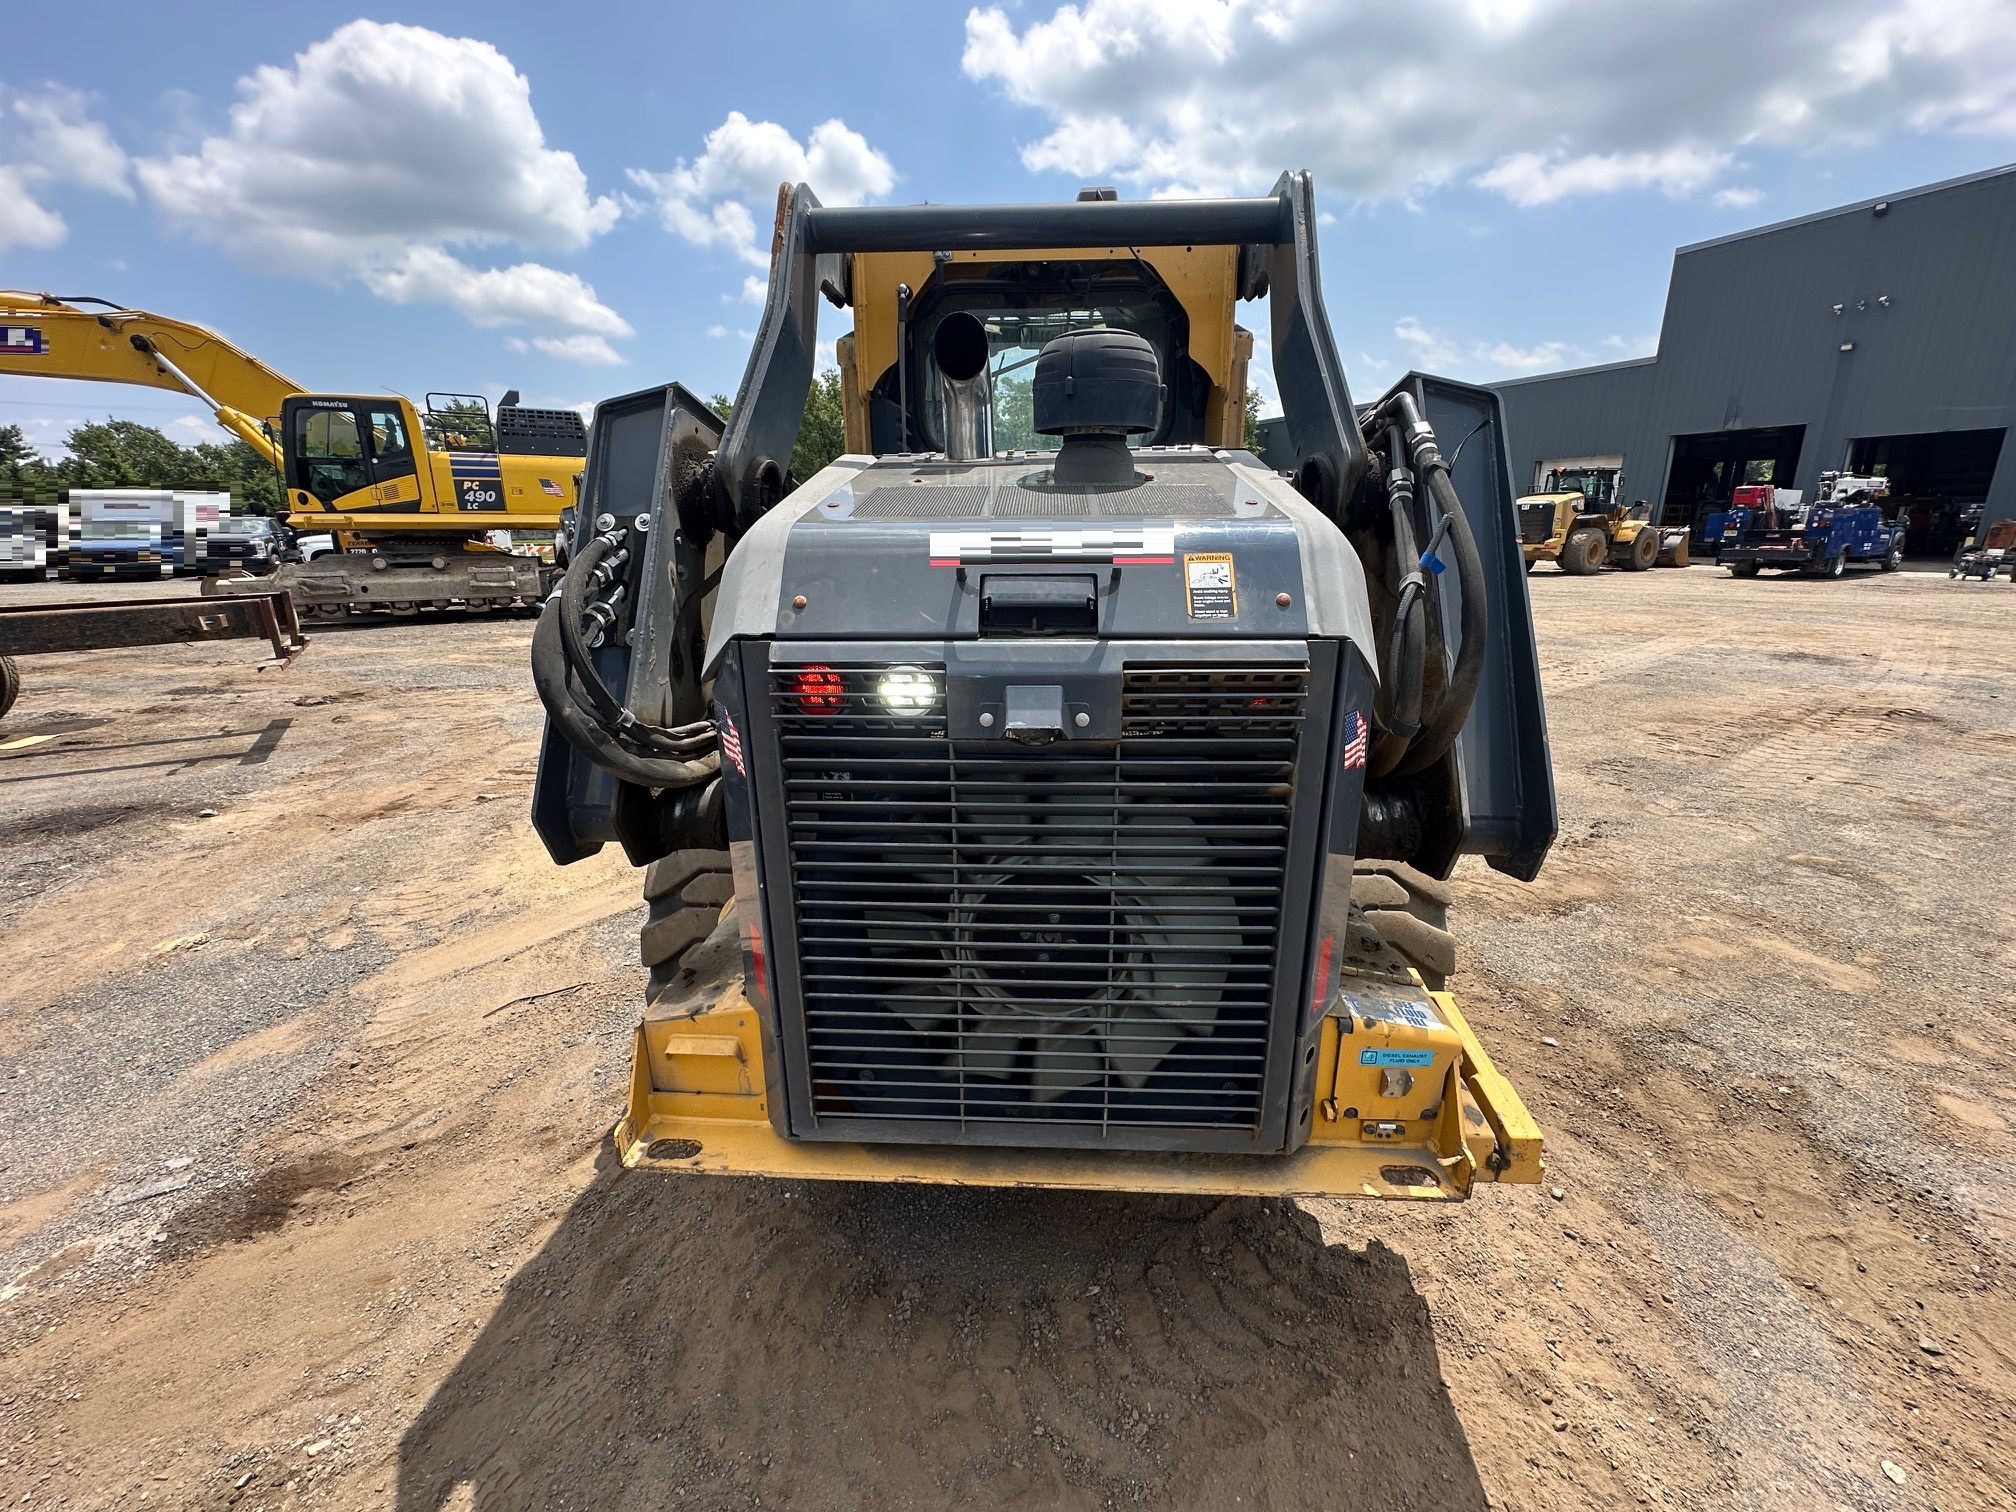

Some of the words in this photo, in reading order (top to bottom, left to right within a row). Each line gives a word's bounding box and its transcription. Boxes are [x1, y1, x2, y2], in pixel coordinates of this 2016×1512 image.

[463, 481, 480, 490] PC
[464, 490, 496, 502] 490
[1394, 1006, 1427, 1018] FLUID
[1405, 1017, 1427, 1026] FILL
